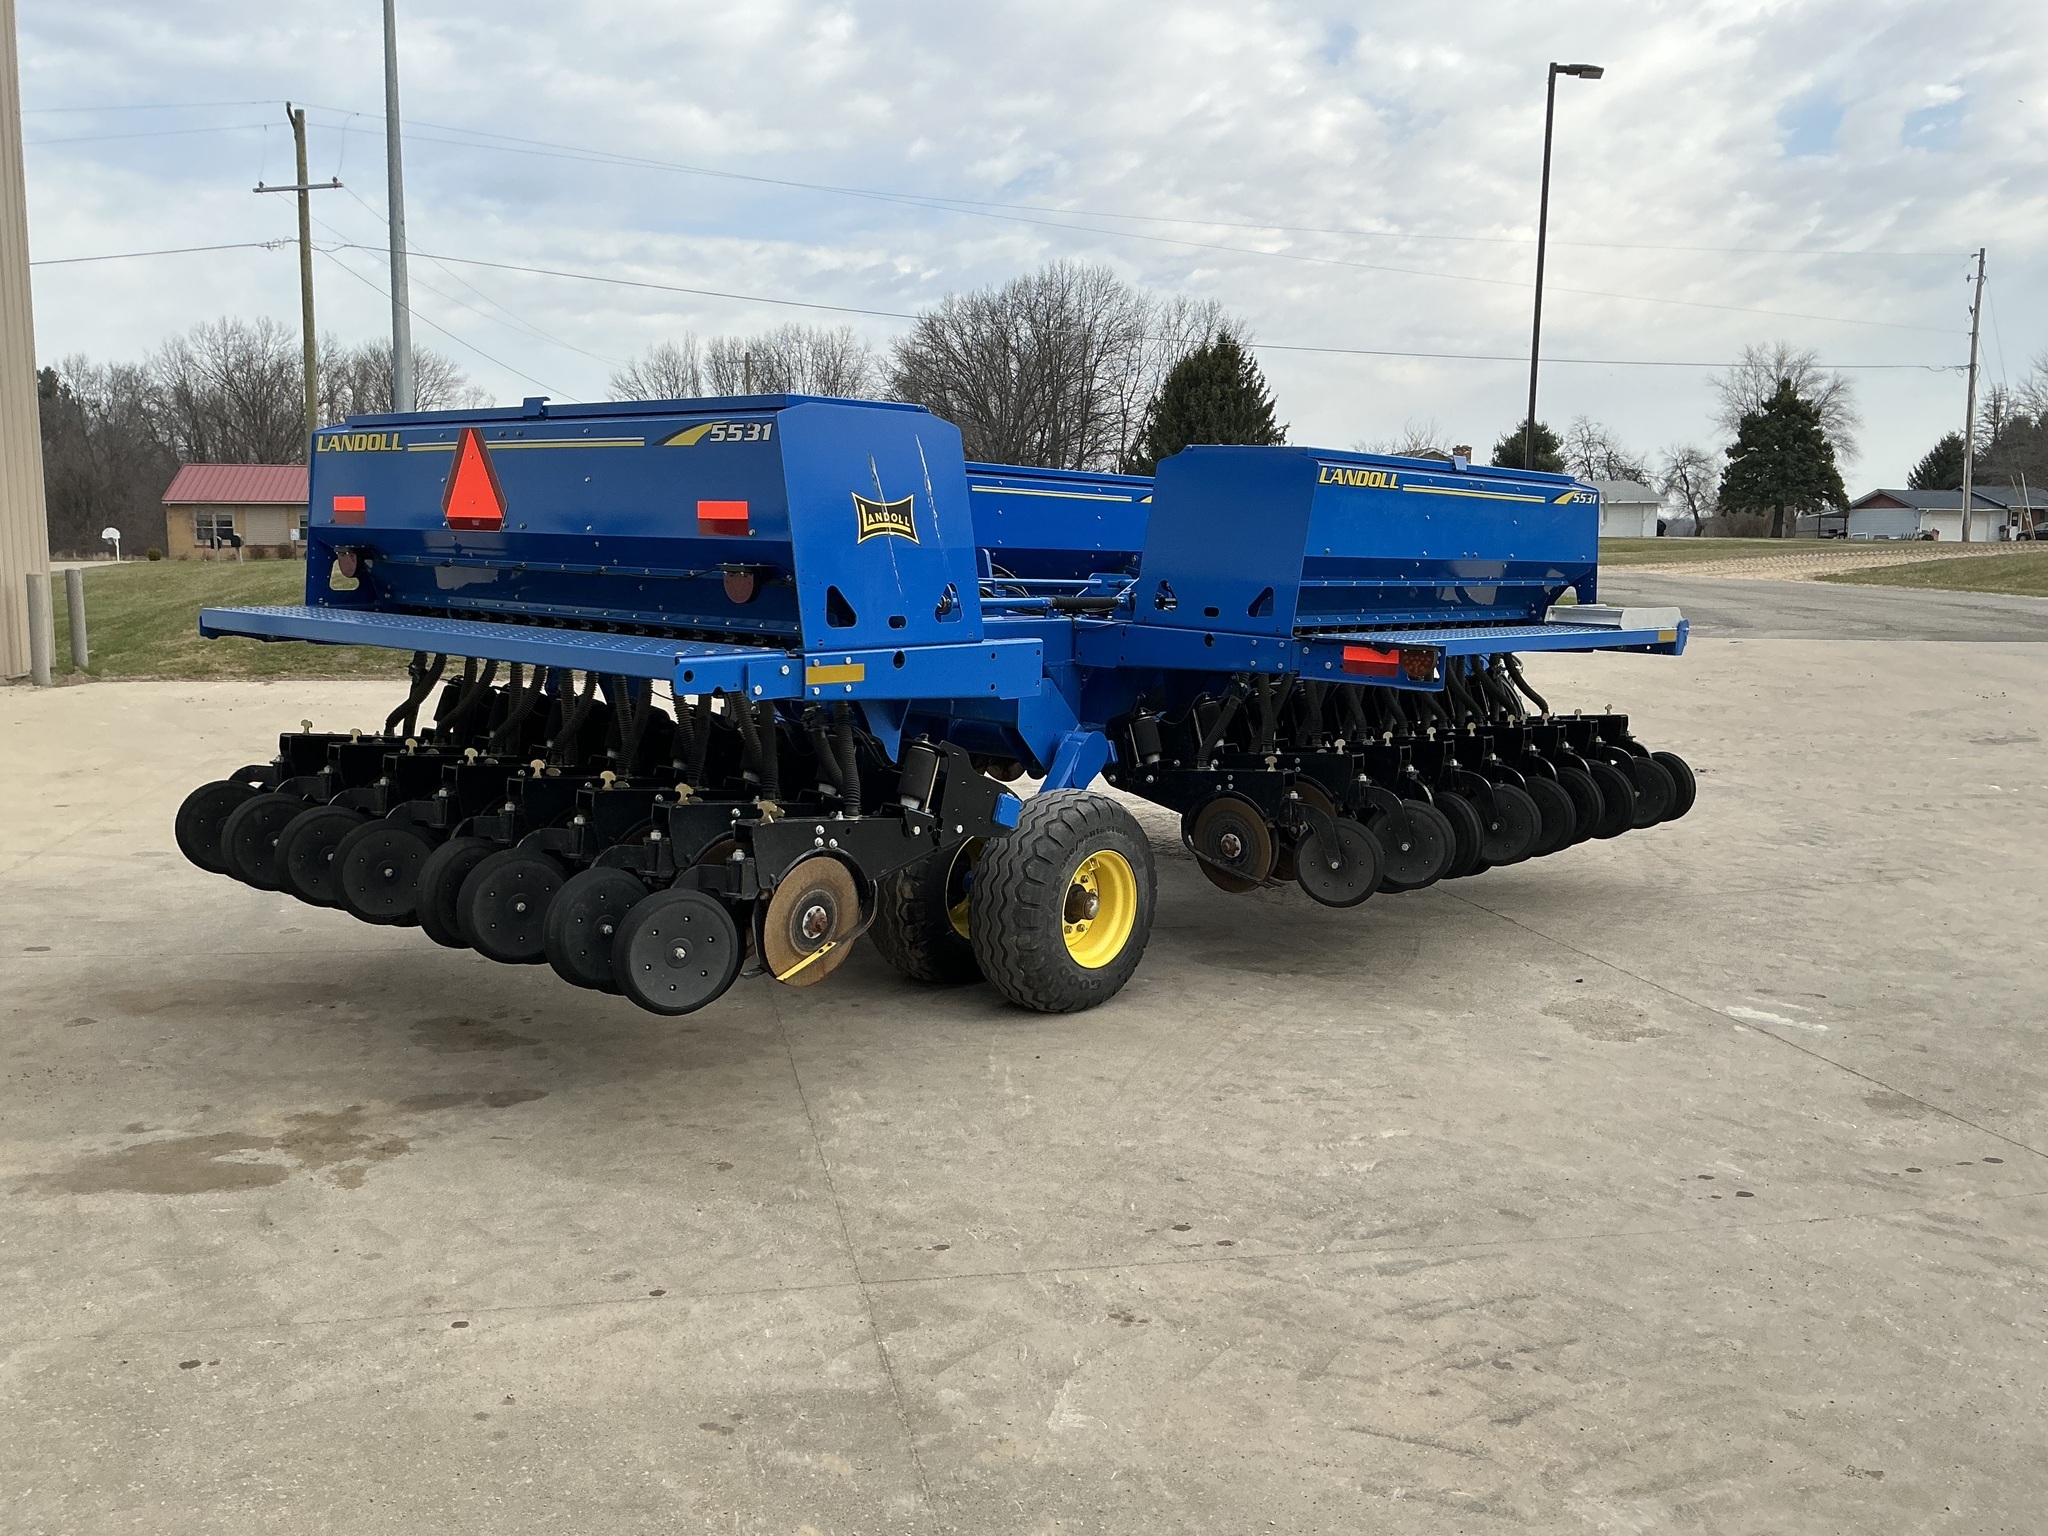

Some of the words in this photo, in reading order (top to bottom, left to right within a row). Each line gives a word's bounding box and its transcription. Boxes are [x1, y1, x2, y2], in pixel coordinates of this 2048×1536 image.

[316, 432, 404, 452] LANDOLL
[709, 423, 773, 442] 5531
[1318, 466, 1399, 489] LANDOLL
[1572, 492, 1597, 504] 5531
[860, 503, 912, 533] LANDOLL
